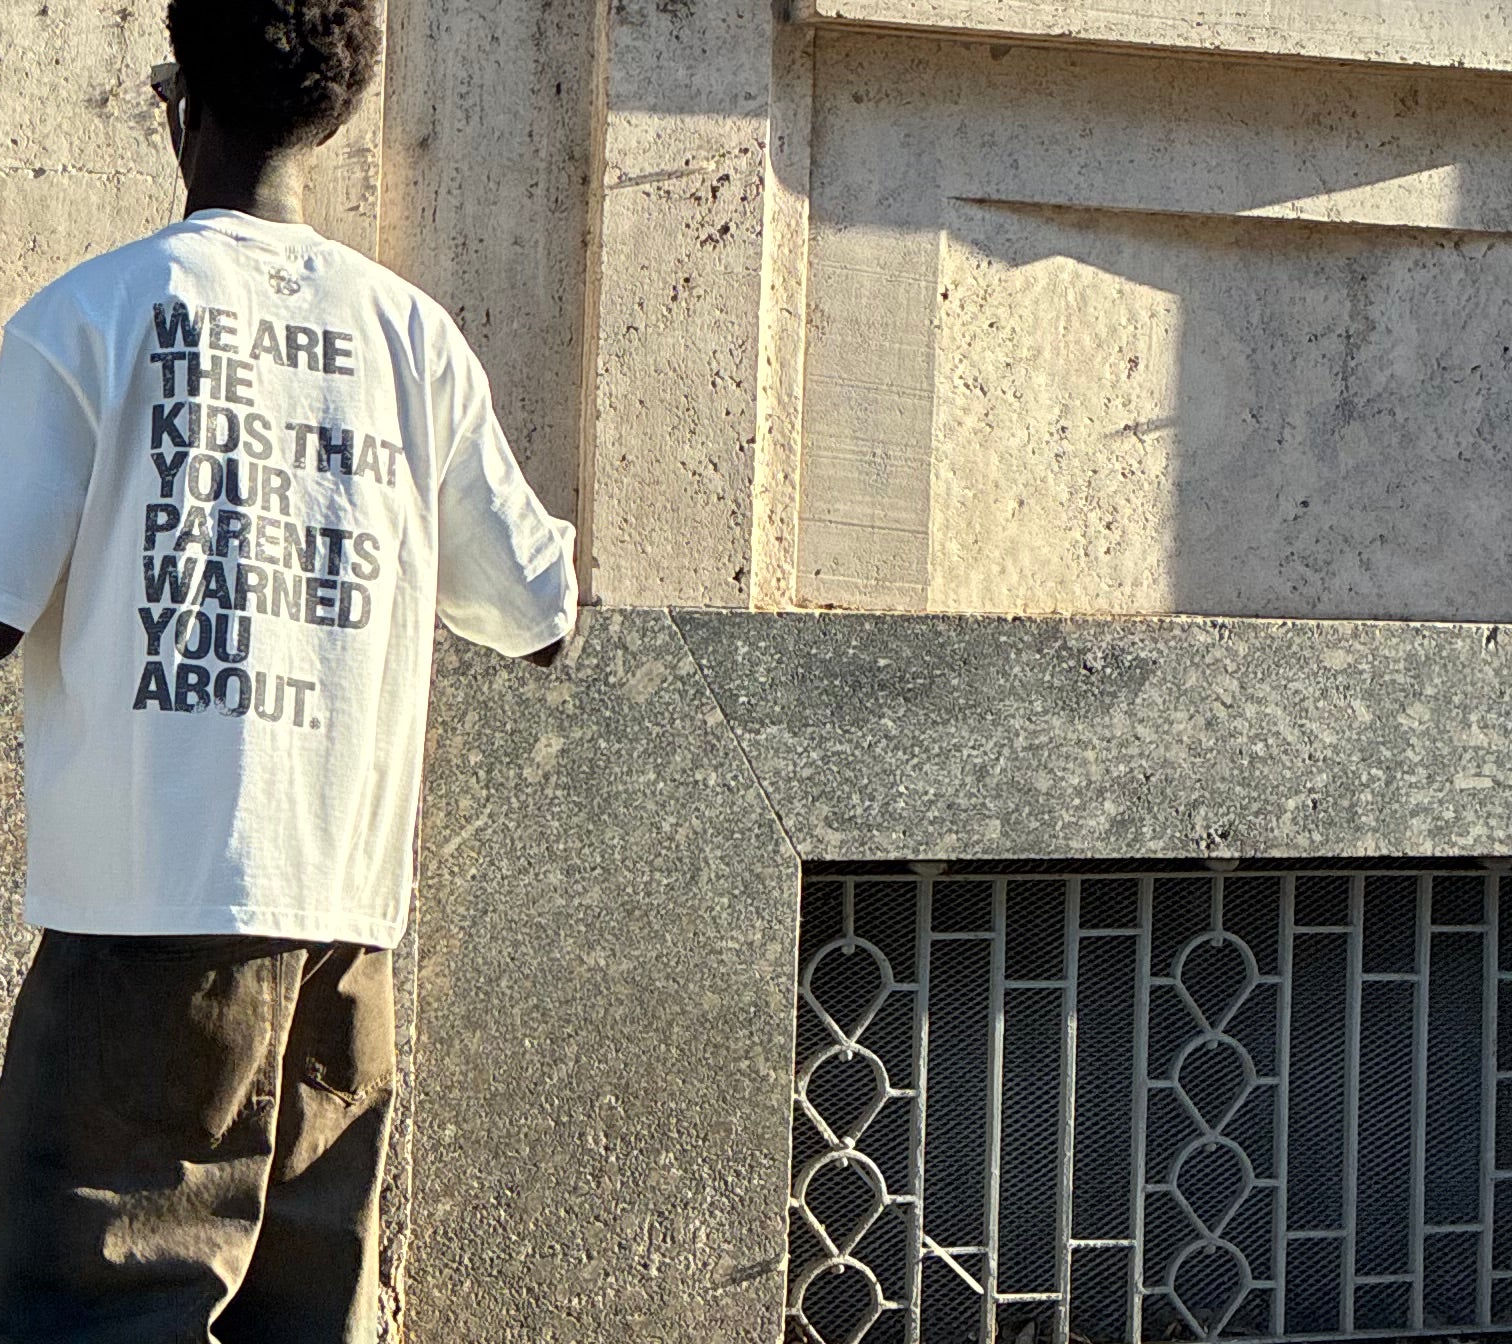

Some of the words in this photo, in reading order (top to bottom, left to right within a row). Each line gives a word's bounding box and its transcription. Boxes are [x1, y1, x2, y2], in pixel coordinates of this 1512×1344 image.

[152, 301, 240, 355] WE
[249, 320, 354, 376] ARE
[149, 351, 256, 408] THE
[150, 401, 273, 461] KIDS
[284, 421, 405, 489] THAT
[150, 452, 292, 517] YOUR
[143, 502, 381, 583] PARENTS
[143, 555, 373, 631] WARNED
[137, 606, 251, 664] YOU
[131, 660, 324, 732] ABOUT.
